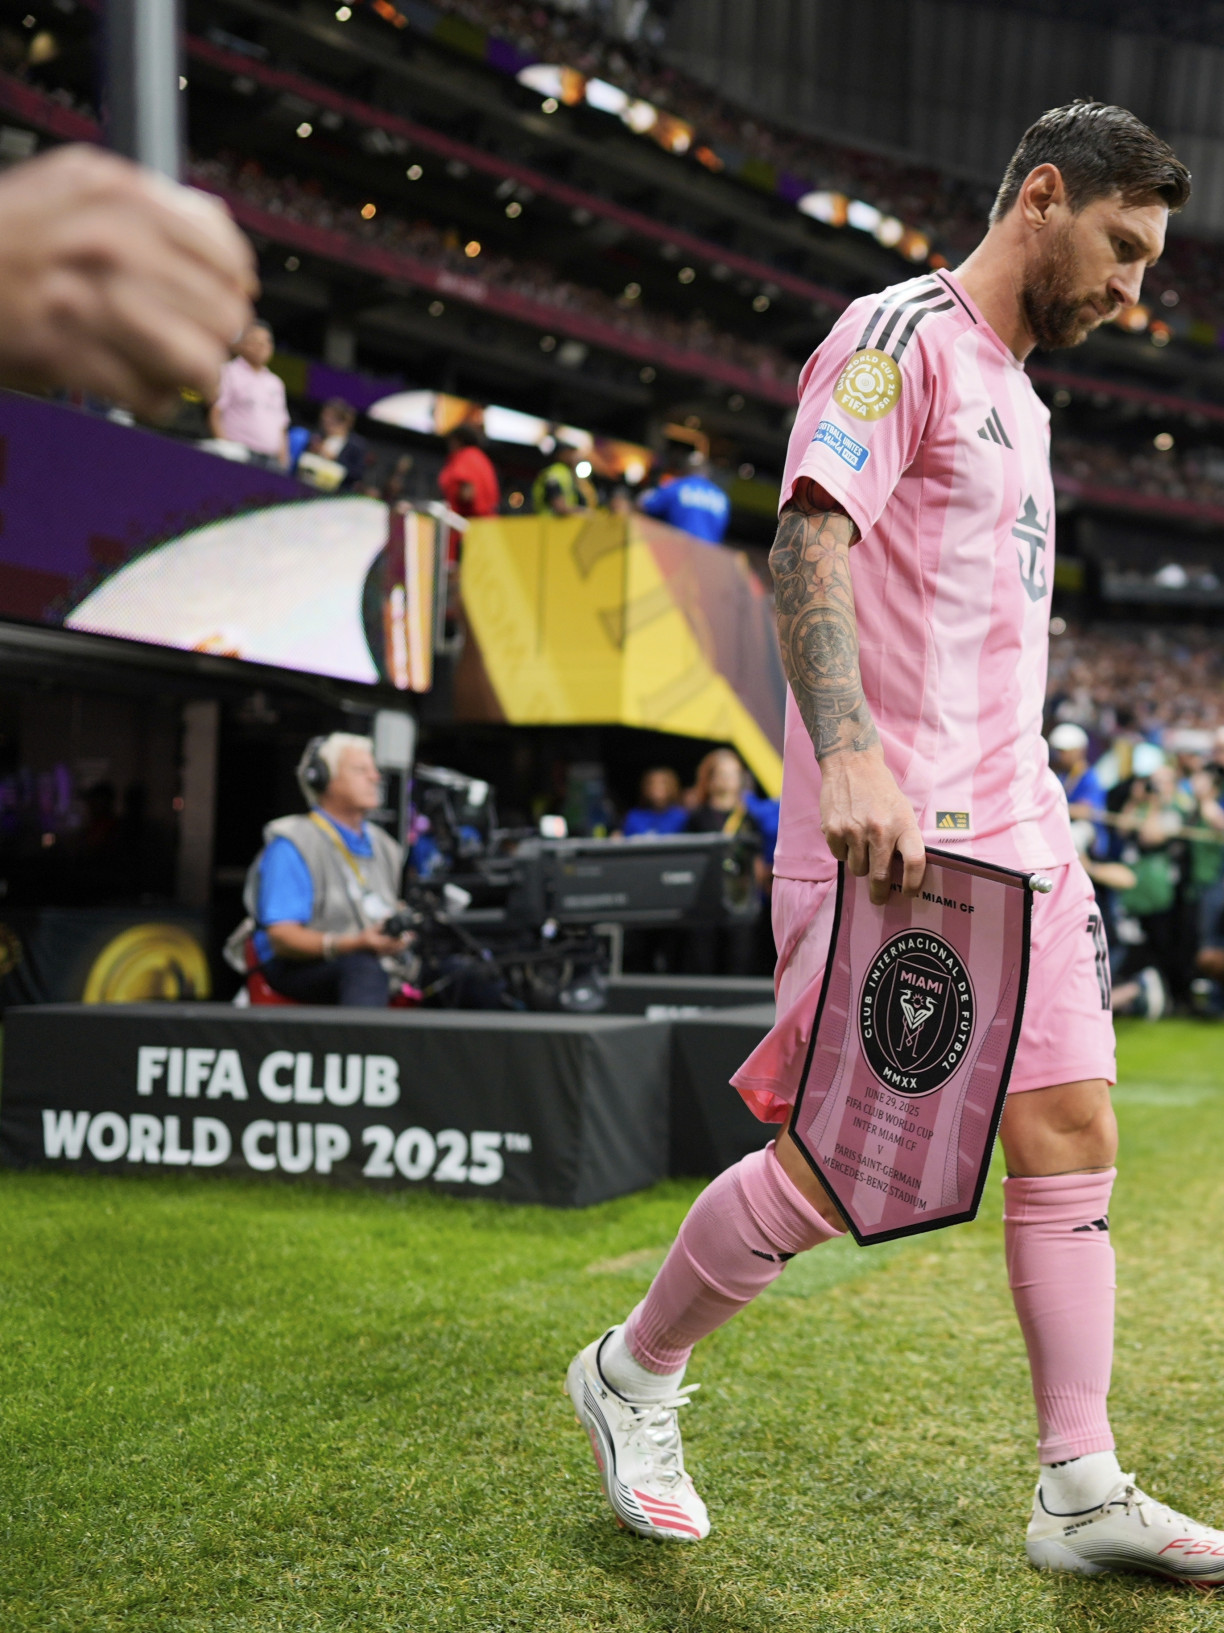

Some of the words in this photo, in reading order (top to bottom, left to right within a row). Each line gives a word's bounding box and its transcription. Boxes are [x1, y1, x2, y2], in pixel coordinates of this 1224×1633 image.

[846, 355, 879, 371] WORLD
[881, 362, 895, 380] CUP
[841, 394, 867, 416] FIFA
[873, 397, 891, 412] USA
[843, 437, 863, 457] UNITES
[843, 450, 857, 463] FIFA
[922, 891, 957, 909] MIAMI
[960, 902, 975, 914] CF
[863, 995, 873, 1039] CLUB
[868, 938, 960, 987] INTERNACIONAL
[957, 981, 969, 1003] DE
[900, 969, 944, 995] MIAMI
[136, 1045, 249, 1101] FIFA
[257, 1050, 401, 1108] CLUB
[882, 1066, 918, 1089] MMXX
[864, 1087, 886, 1102] JUNE
[885, 1095, 897, 1109] 29,
[898, 1100, 920, 1117] 2025
[845, 1095, 862, 1111] FIFA
[863, 1103, 885, 1120] CLUB
[885, 1112, 916, 1133] WORLD
[916, 1125, 934, 1140] CUP
[41, 1109, 233, 1167] WORLD
[241, 1118, 352, 1175] CUP
[852, 1117, 877, 1136] INTER
[878, 1127, 904, 1147] MIAMI
[905, 1139, 918, 1152] CF
[834, 1143, 857, 1161] PARIS
[856, 1153, 922, 1190] SAINT-GERMAIN
[823, 1155, 889, 1193] MERCEDES-BENZ
[889, 1185, 927, 1211] STADIUM
